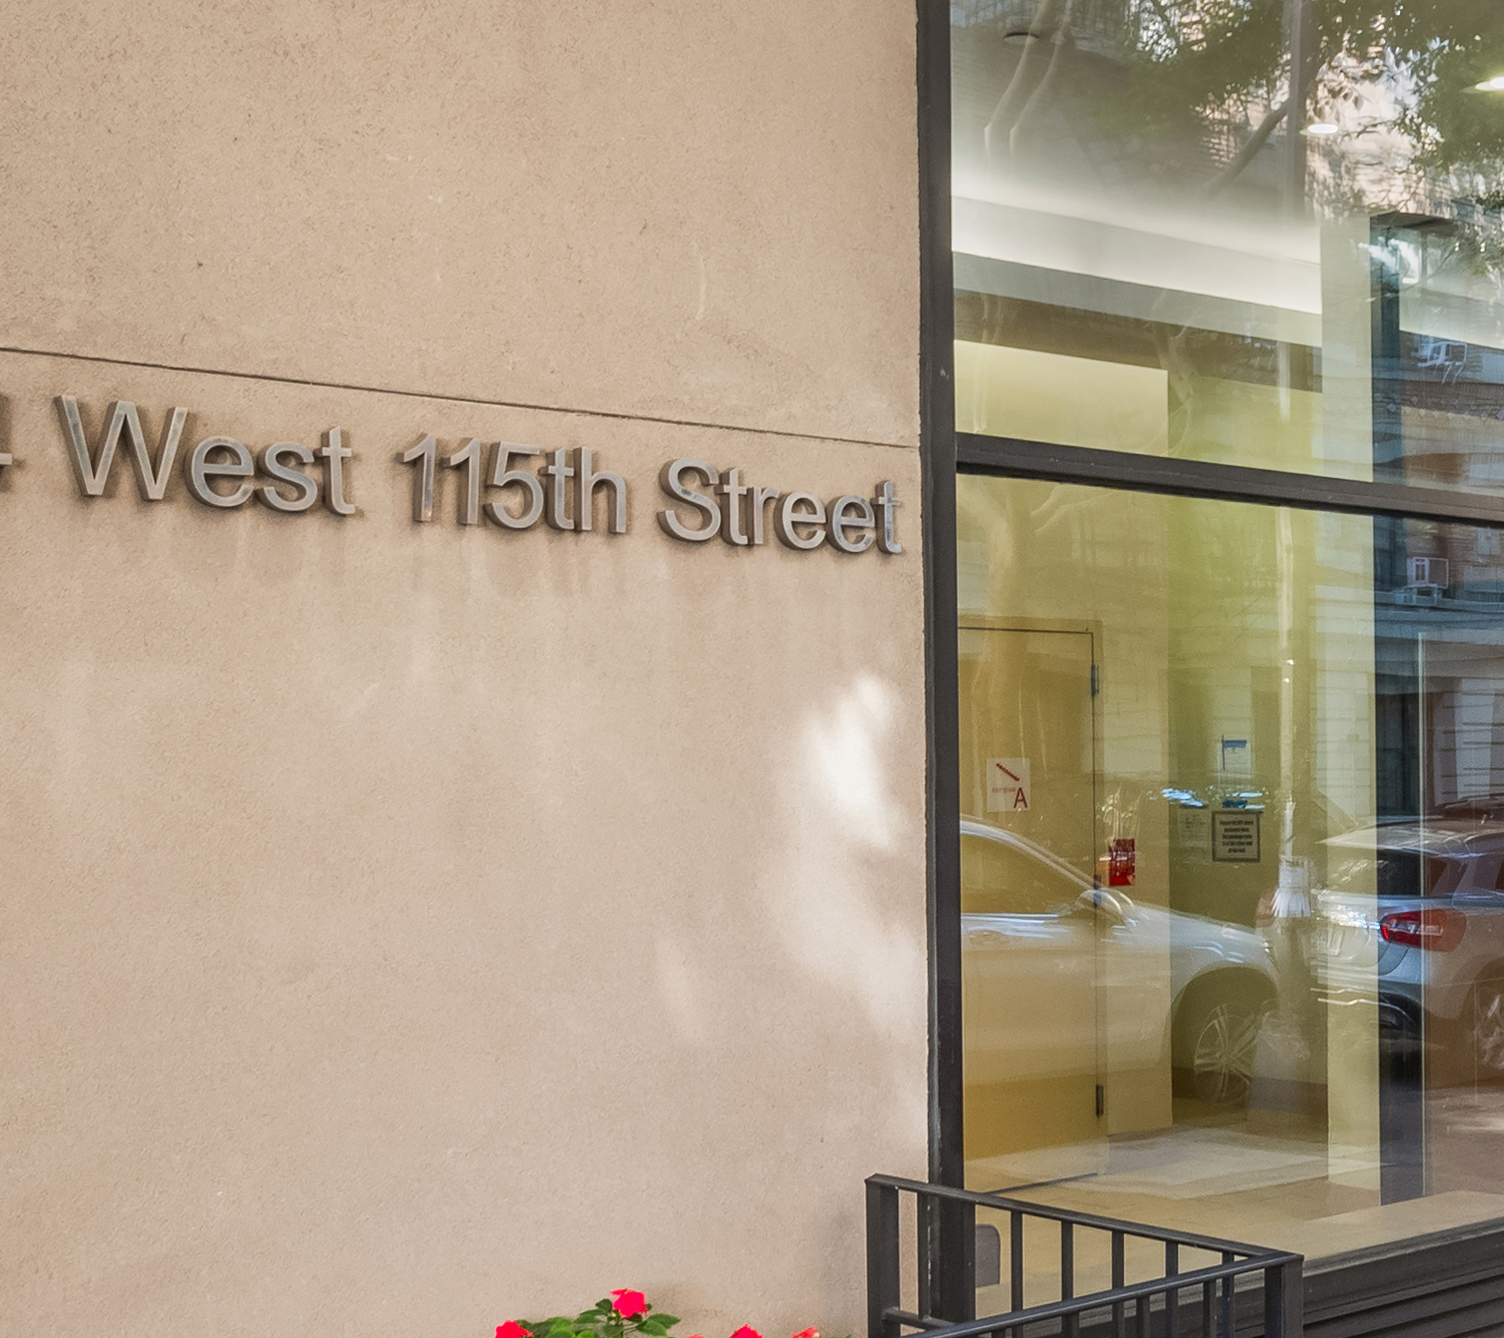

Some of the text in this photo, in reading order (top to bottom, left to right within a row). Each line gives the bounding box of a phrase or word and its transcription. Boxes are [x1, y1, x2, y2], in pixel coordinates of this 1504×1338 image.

[53, 394, 356, 515] West
[395, 432, 627, 534] 115th
[657, 458, 903, 554] Street
[1013, 787, 1028, 809] A
